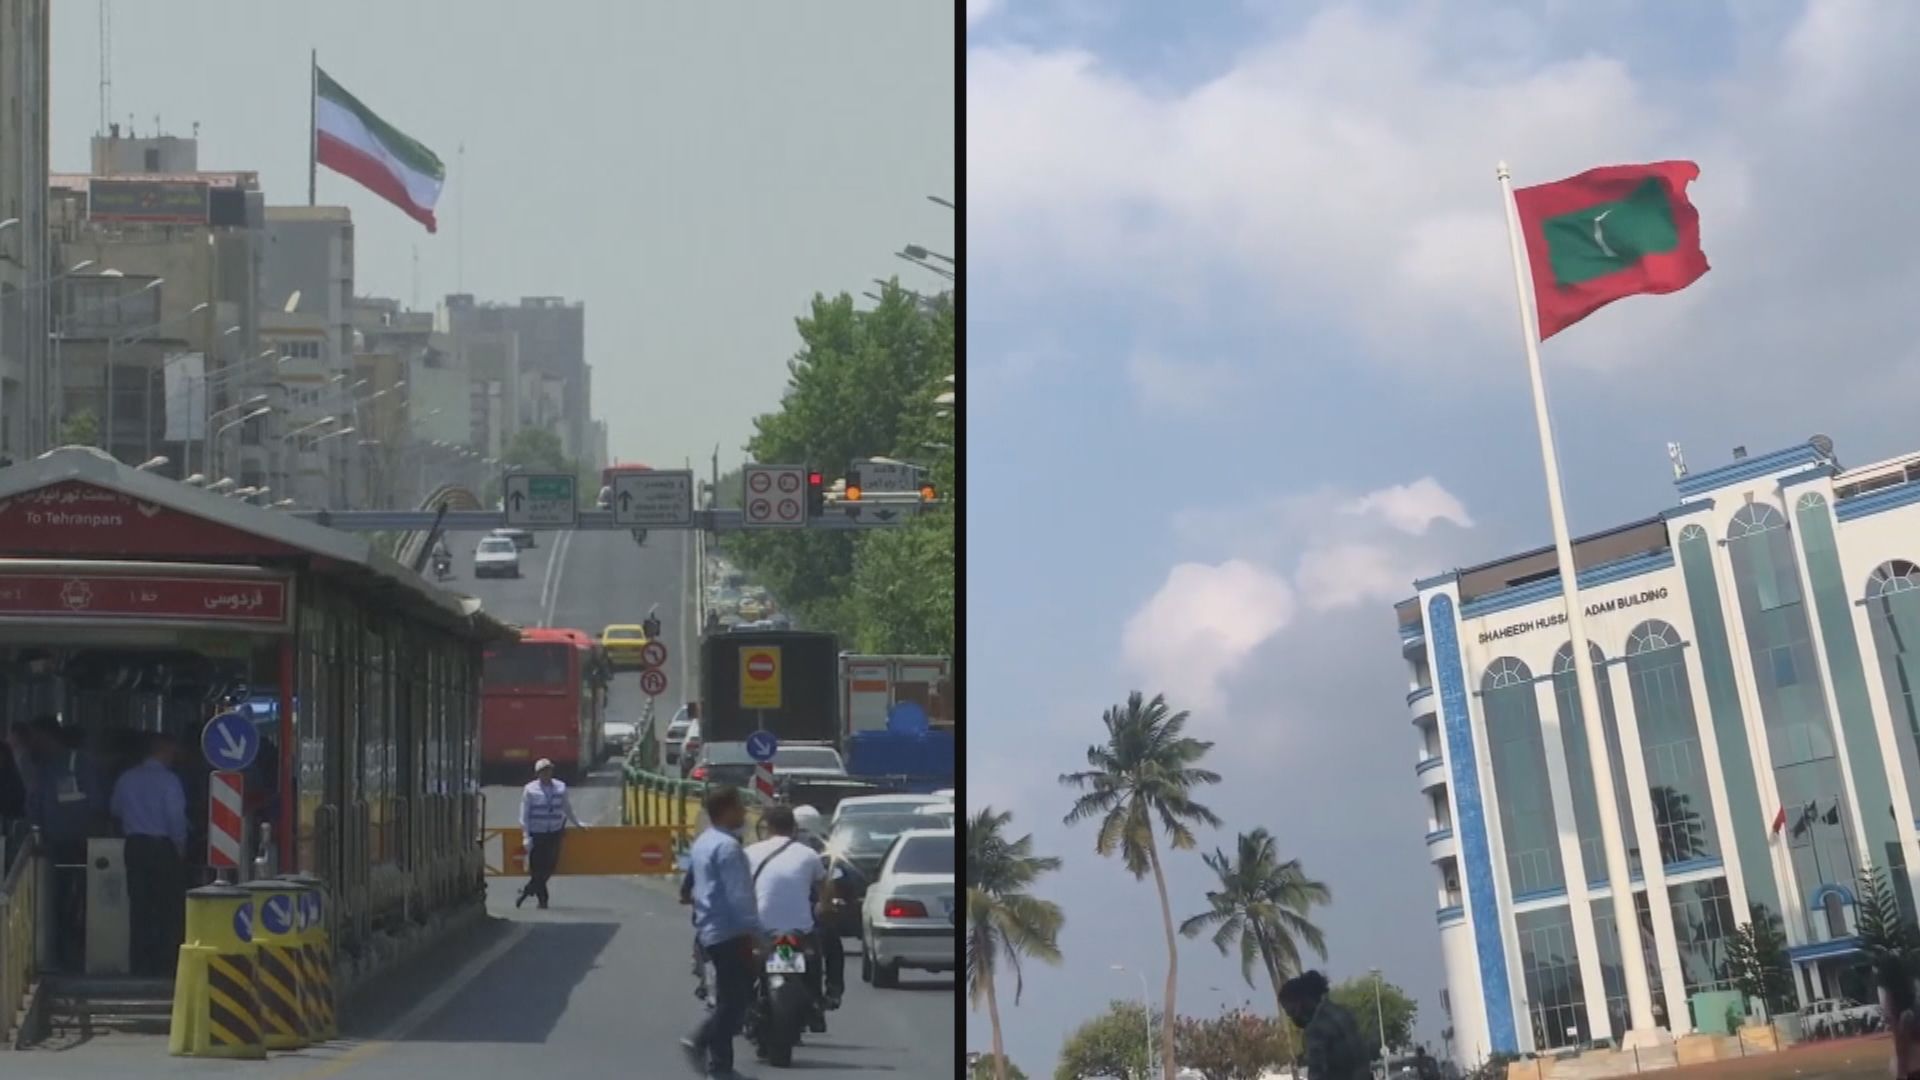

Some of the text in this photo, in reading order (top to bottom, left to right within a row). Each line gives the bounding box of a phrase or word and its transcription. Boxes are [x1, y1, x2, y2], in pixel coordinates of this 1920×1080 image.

[27, 511, 123, 527] To Tehranpars
[141, 590, 158, 602] خط
[204, 589, 263, 609] فردوسی
[1478, 620, 1534, 644] SHAHEEDH
[1584, 599, 1616, 617] ADAM
[1617, 587, 1668, 610] BUILDING
